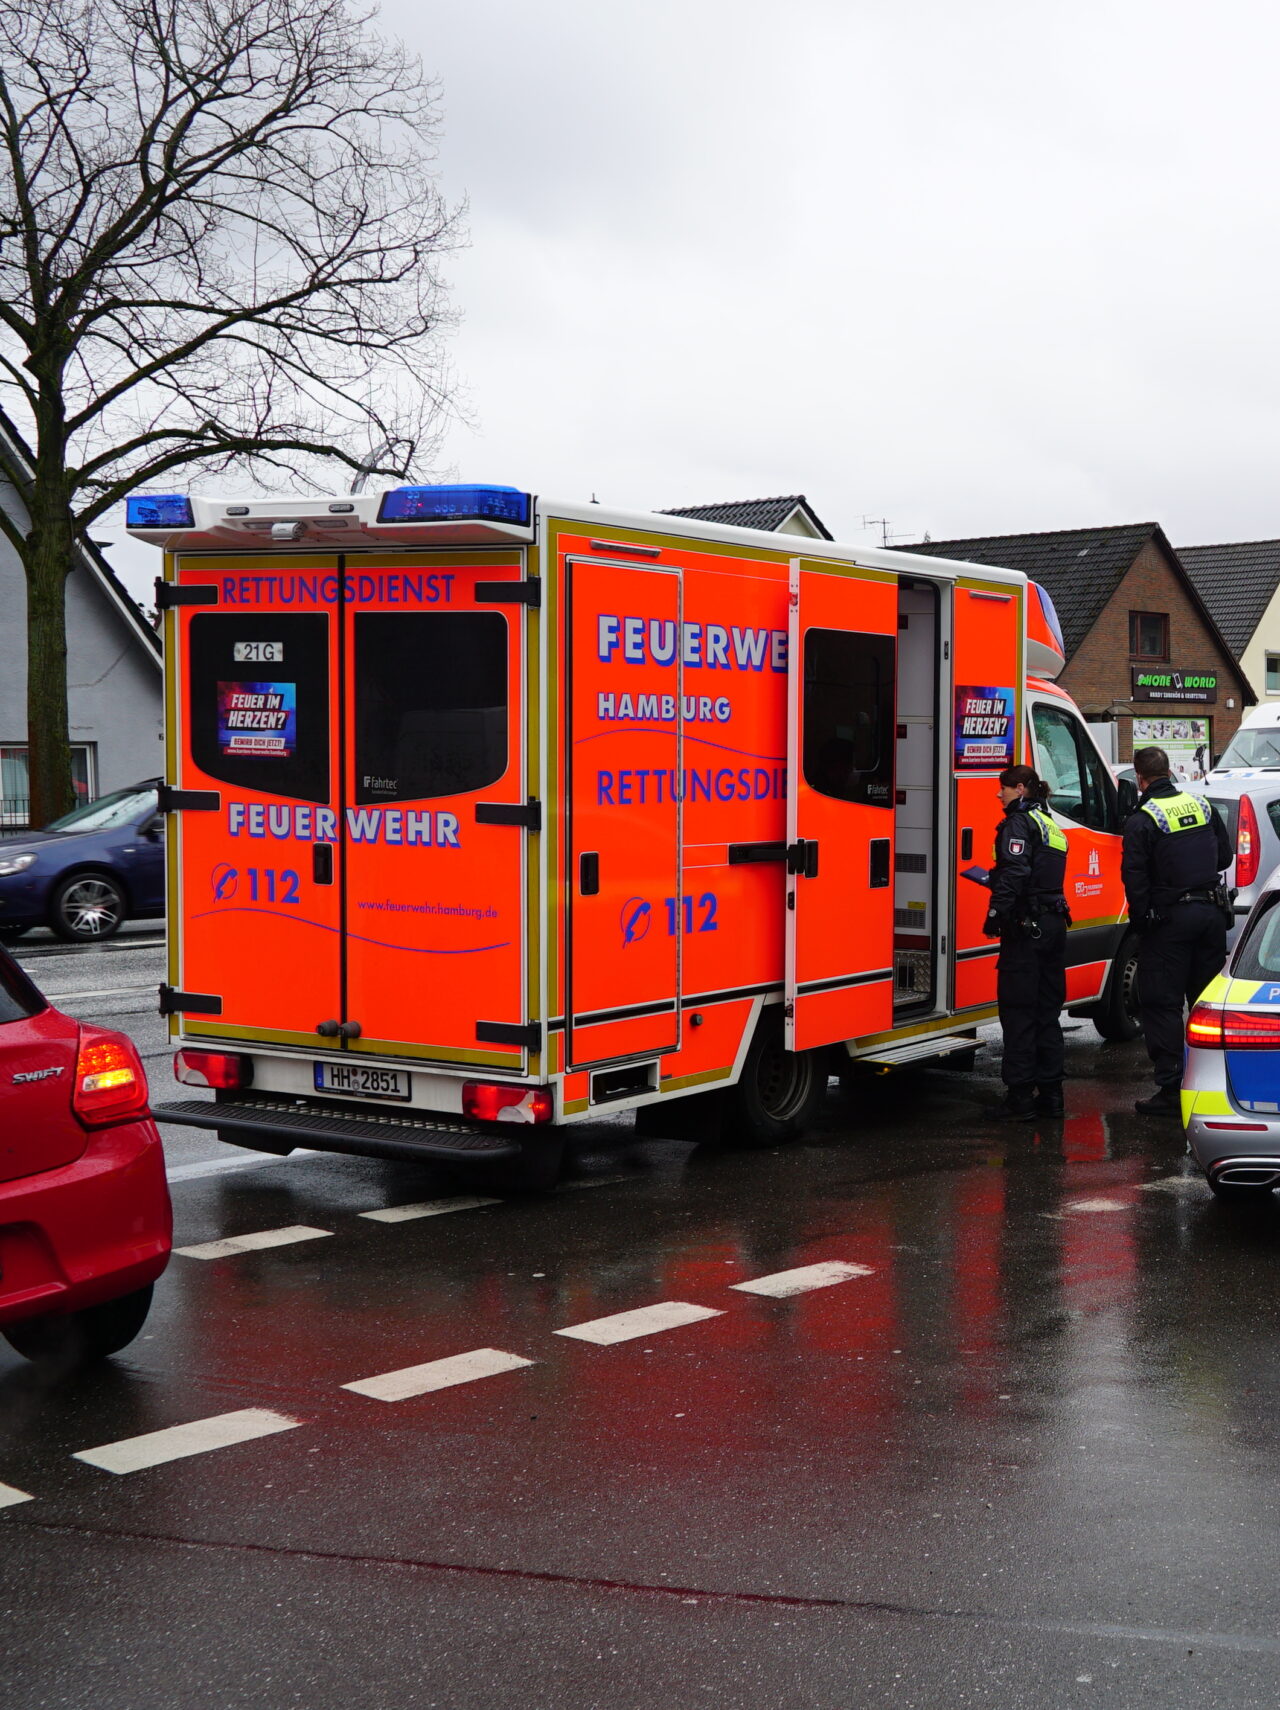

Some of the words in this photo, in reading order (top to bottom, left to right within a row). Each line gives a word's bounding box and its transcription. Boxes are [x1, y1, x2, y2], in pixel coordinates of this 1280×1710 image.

[223, 573, 456, 604] RETTUNGSDIENST
[1184, 676, 1216, 688] WORLD
[231, 693, 265, 709] FEUER
[267, 694, 281, 709] IM
[598, 691, 731, 723] HAMBURG
[966, 698, 992, 714] FEUER
[993, 699, 1005, 715] IM
[228, 710, 286, 729] HERZEN?
[963, 716, 1008, 735] HERZEN?
[1166, 802, 1200, 818] POLIZEI
[228, 802, 462, 849] FEUERWEHR
[247, 868, 300, 904] 112
[357, 898, 499, 920] www.feuerwehr.hamburg.de
[664, 892, 718, 936] 112
[12, 1066, 64, 1085] SWIFT
[331, 1066, 351, 1088] HH
[361, 1070, 400, 1093] 2851
